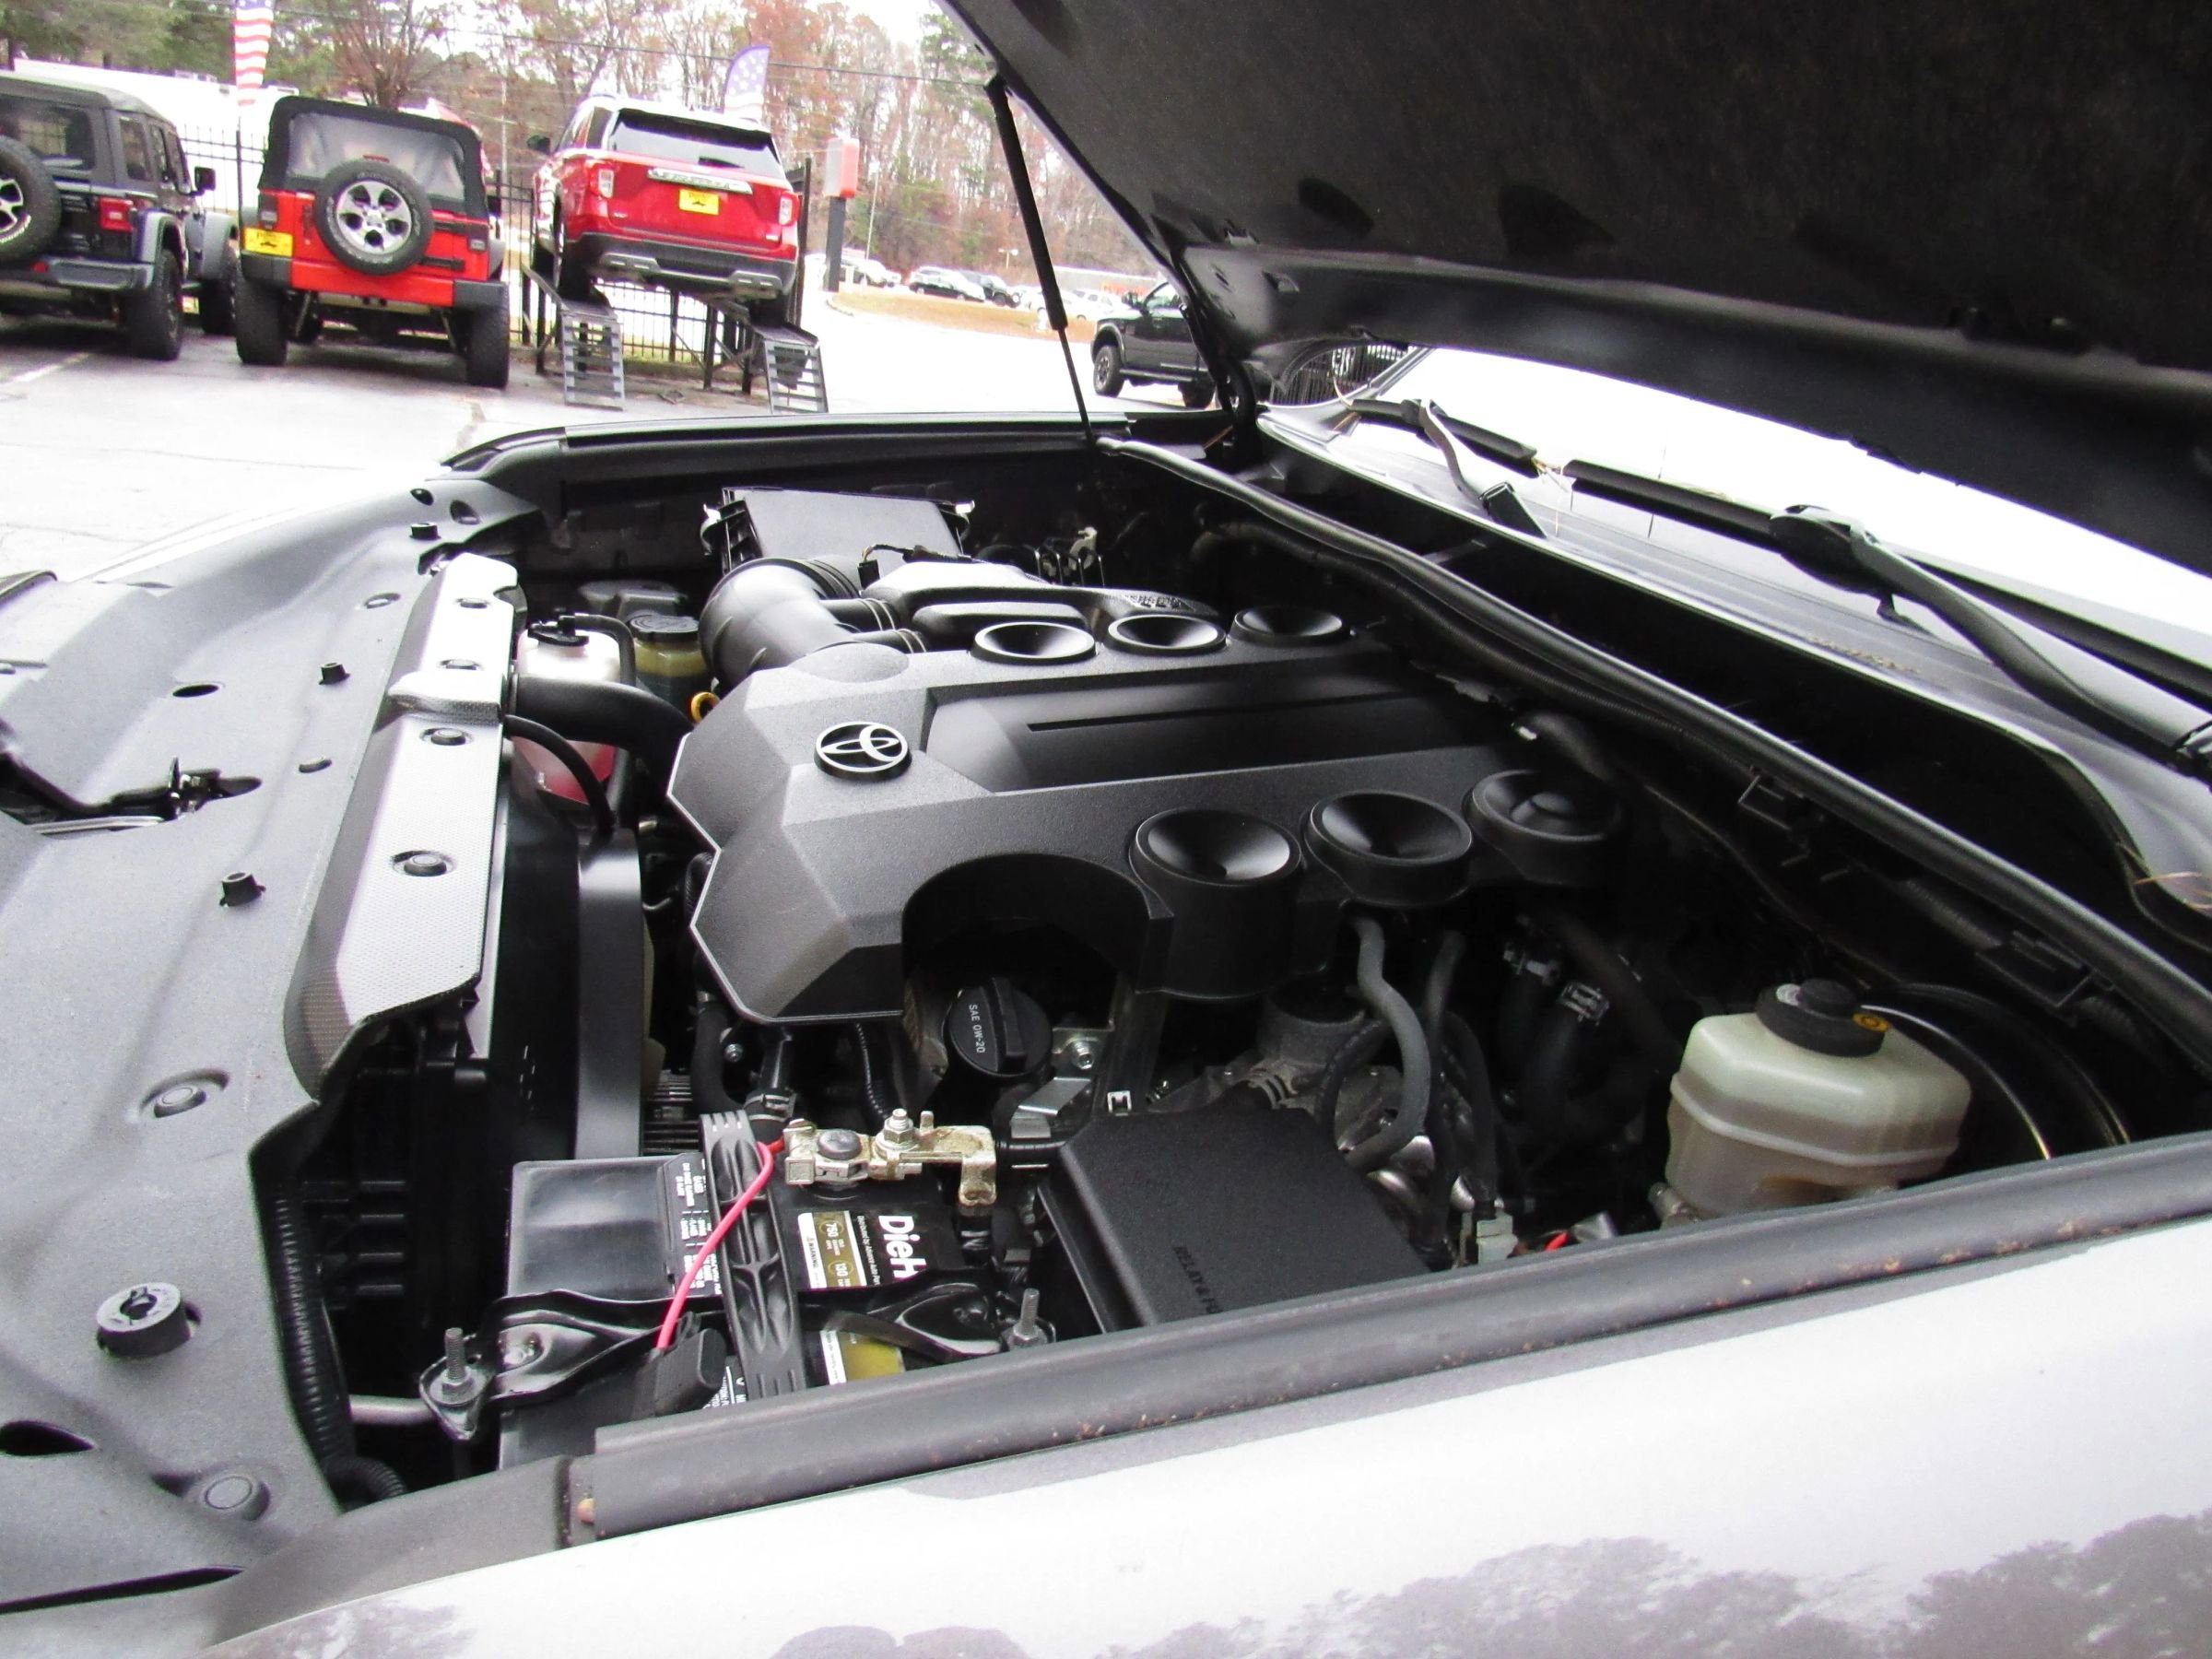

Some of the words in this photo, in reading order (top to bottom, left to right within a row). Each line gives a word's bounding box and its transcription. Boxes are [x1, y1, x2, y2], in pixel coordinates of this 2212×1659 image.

[969, 1004, 981, 1021] SAE
[972, 1024, 985, 1053] 0W-20
[826, 1222, 839, 1238] 750
[878, 1215, 927, 1278] DieH
[835, 1263, 849, 1277] 130
